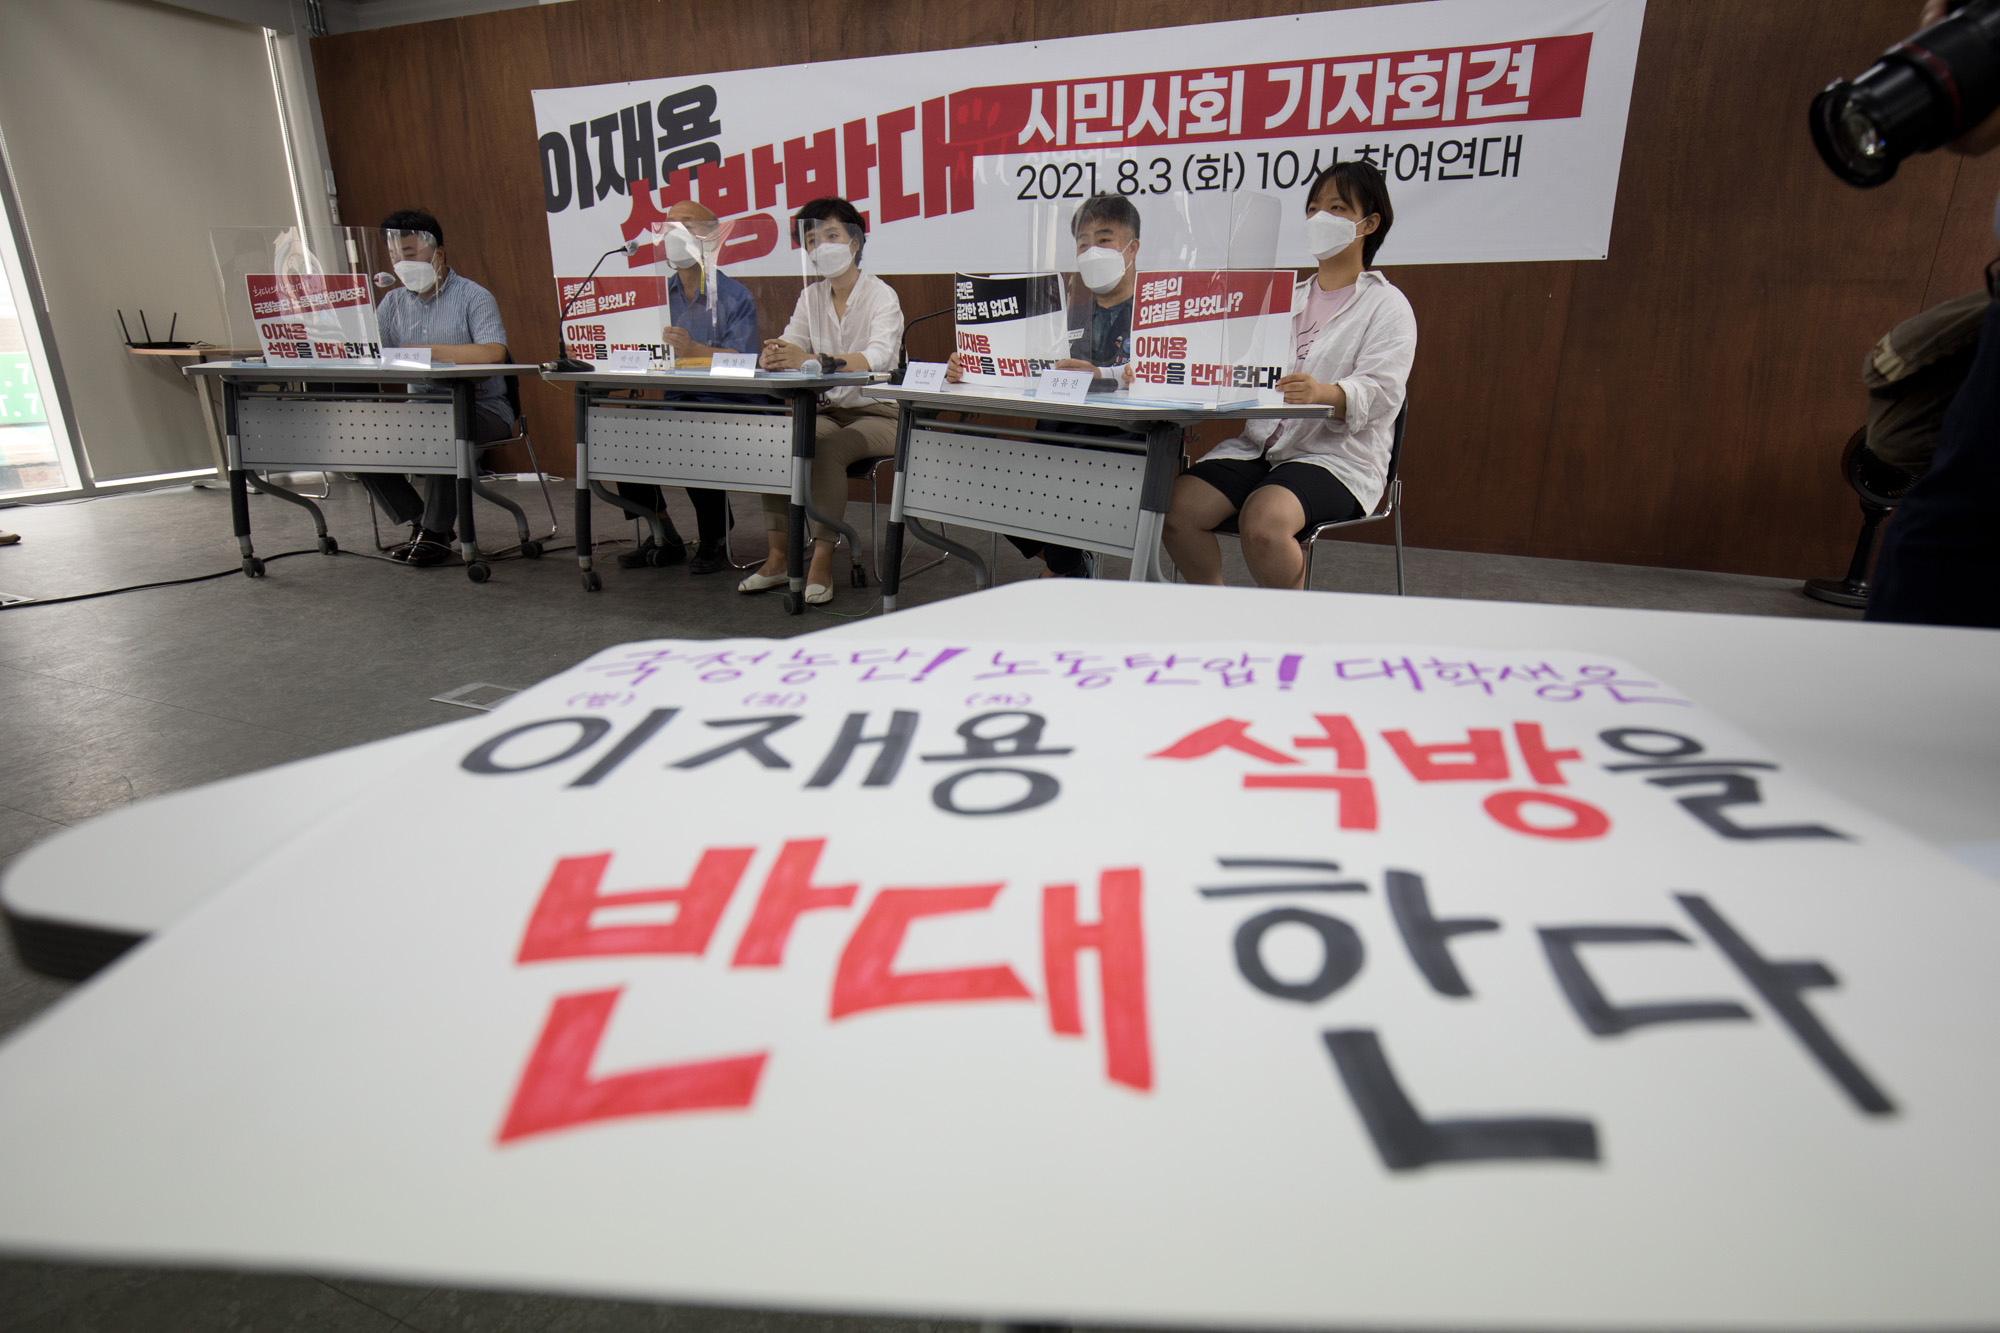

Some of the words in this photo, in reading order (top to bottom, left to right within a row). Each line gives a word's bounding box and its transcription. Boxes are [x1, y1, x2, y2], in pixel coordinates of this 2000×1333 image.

[1018, 70, 1245, 146] 시민사회
[1265, 44, 1537, 130] 기자회견
[537, 84, 722, 214] 이재용
[1182, 151, 1246, 195] (화)
[254, 299, 292, 315] 국정농단
[328, 286, 366, 303] 회계조작
[563, 280, 595, 300] 촛불의
[598, 290, 637, 311] 잊었나?
[1141, 276, 1182, 303] 촛불의
[977, 301, 990, 319] 적
[990, 296, 1019, 318] 없다!
[1139, 300, 1181, 326] 외침을
[1183, 291, 1244, 319] 잊었나?
[261, 323, 308, 341] 이재용
[567, 324, 606, 342] 이재용
[957, 330, 991, 355] 이재용
[268, 342, 314, 359] 석방을
[314, 342, 381, 359] 반대한다!
[1135, 336, 1188, 360] 이재용
[959, 352, 997, 376] 석방을
[1135, 361, 1186, 385] 석방을
[586, 648, 969, 686] 국정농단!
[973, 650, 1304, 690] 노동탄압!
[1333, 655, 1694, 707] 대학생은
[459, 706, 1075, 818] 이재용
[1142, 713, 1860, 844] 석방을
